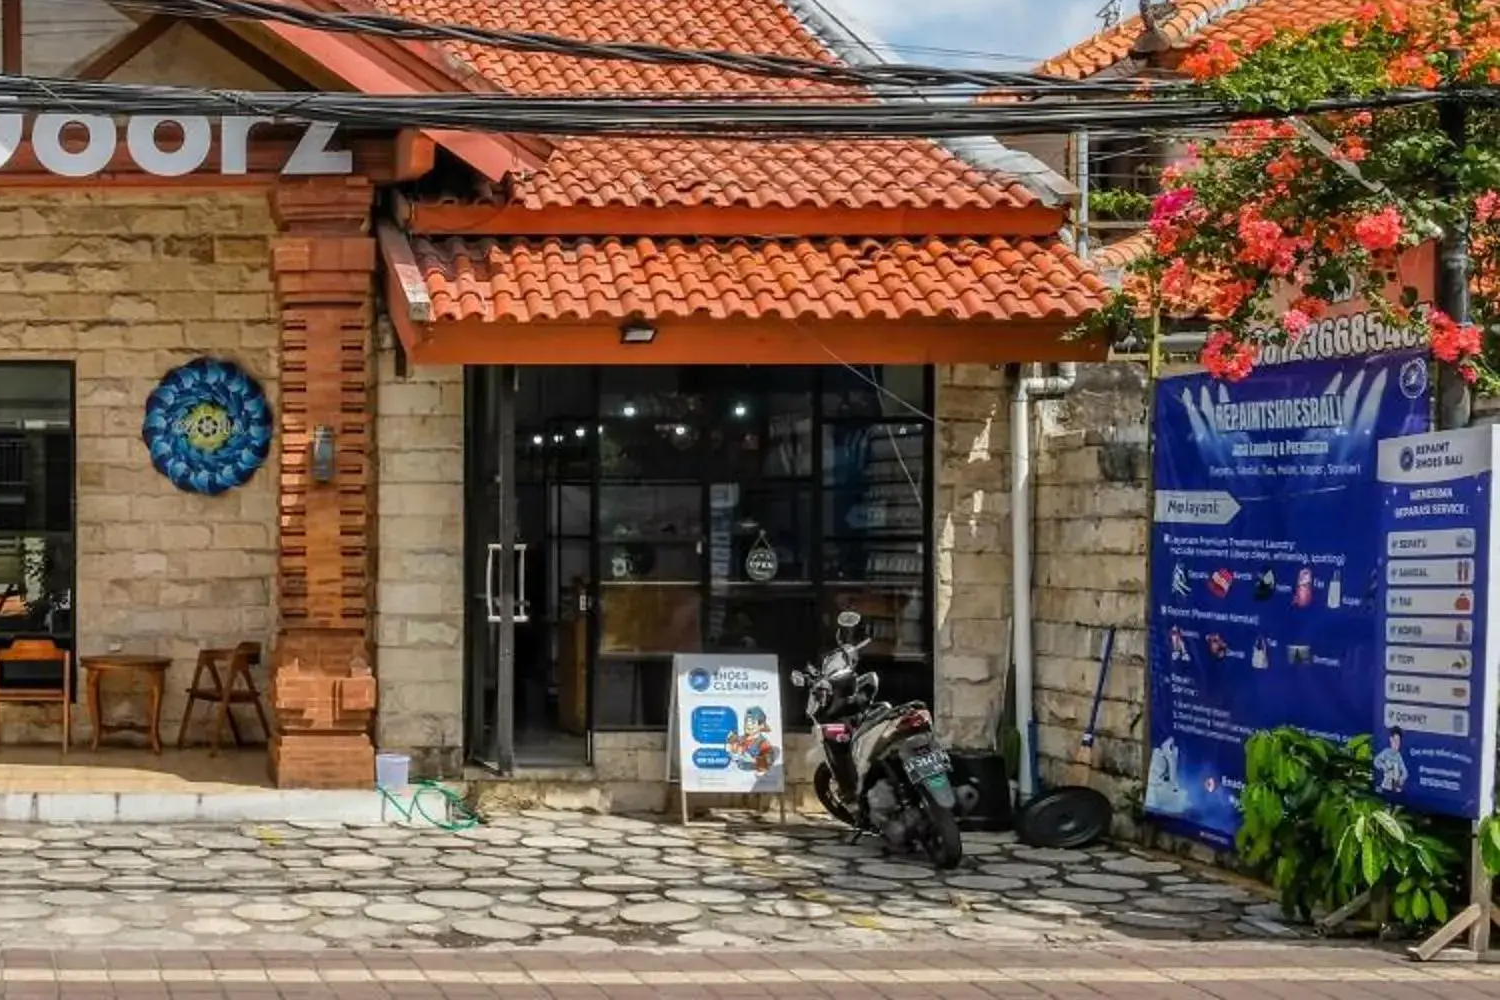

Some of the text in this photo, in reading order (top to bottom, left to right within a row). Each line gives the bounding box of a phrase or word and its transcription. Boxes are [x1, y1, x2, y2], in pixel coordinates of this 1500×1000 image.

[1214, 394, 1344, 431] REPAINTSHOESBALI
[1415, 441, 1451, 455] REPAINT
[1415, 454, 1464, 469] SHOES BALI
[1432, 504, 1465, 515] SERVICE
[1399, 538, 1427, 549] SEPATU
[713, 670, 749, 681] SHOES
[713, 681, 769, 691] CLEANING
